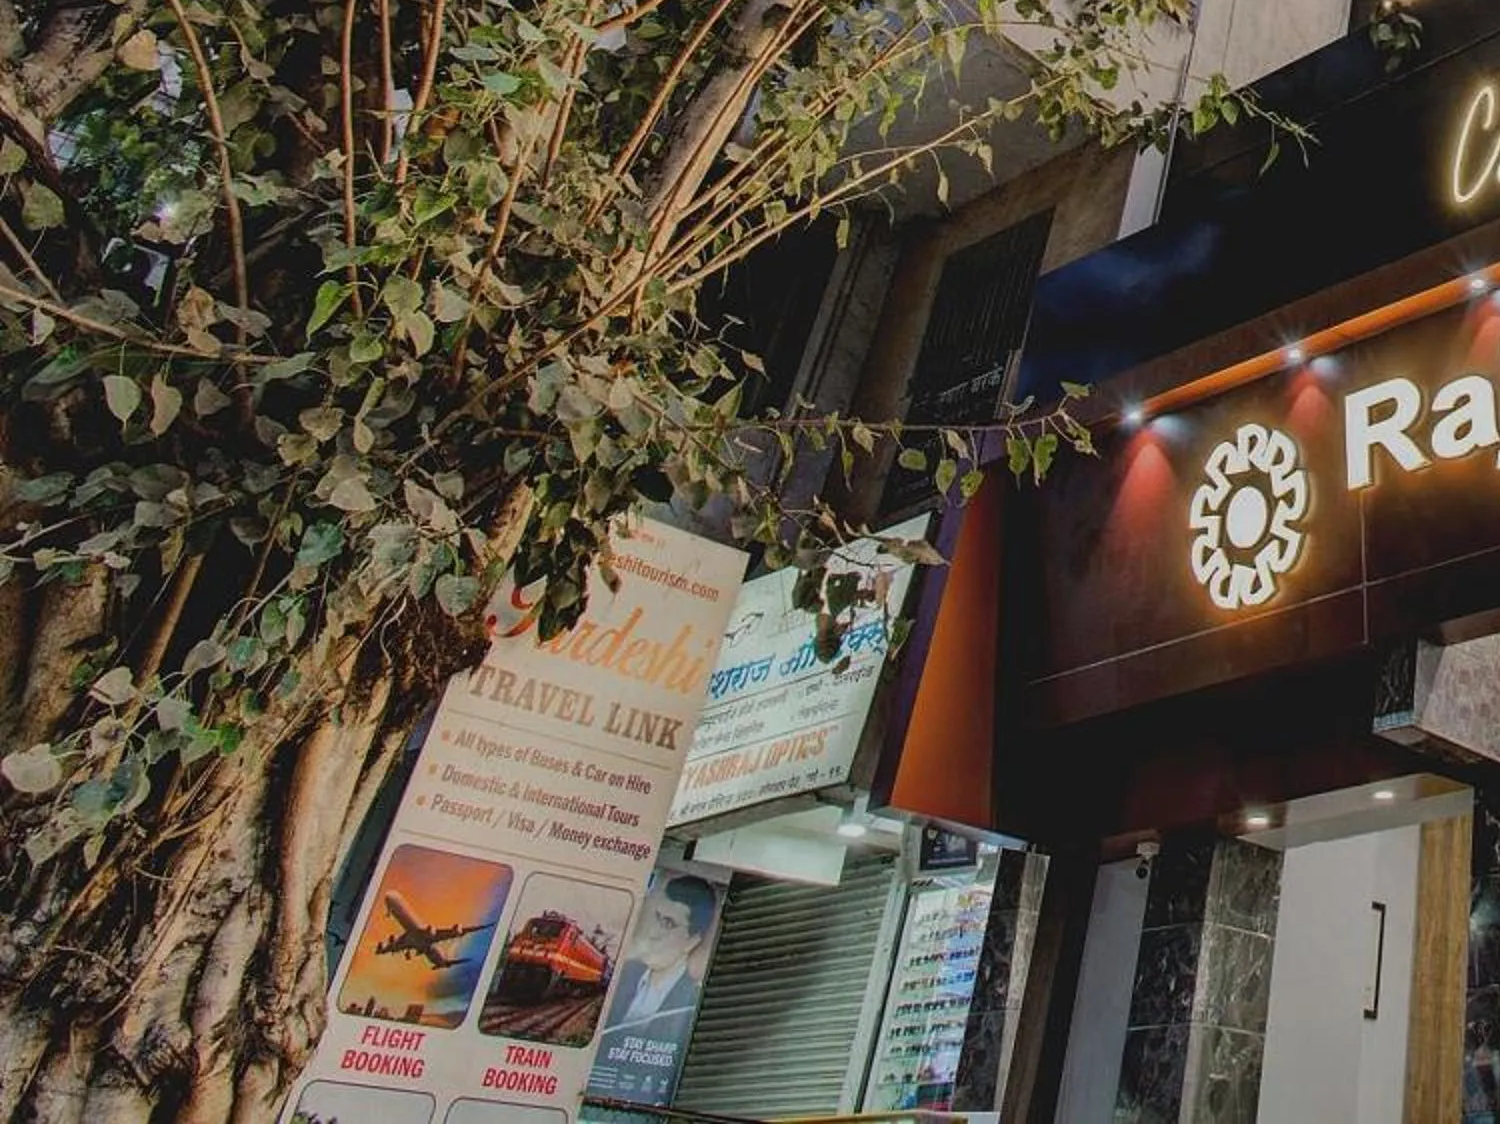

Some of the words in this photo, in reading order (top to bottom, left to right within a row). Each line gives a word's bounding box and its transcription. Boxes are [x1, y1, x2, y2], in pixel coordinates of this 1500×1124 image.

[607, 554, 720, 602] eshitourism.com
[469, 663, 596, 727] TRAVEL
[602, 701, 684, 751] LINK
[454, 729, 475, 749] All
[476, 737, 512, 761] types
[514, 747, 530, 763] of
[571, 761, 584, 777] &
[584, 763, 608, 783] Car
[607, 772, 624, 788] on
[624, 773, 652, 795] Hire
[441, 763, 506, 795] Domestic
[508, 780, 521, 798] &
[606, 804, 640, 827] Tours
[431, 794, 494, 823] Passport
[507, 811, 536, 833] Visa
[548, 821, 592, 851] Money
[592, 834, 652, 861] exchange
[361, 1025, 426, 1051] FLIGHT
[504, 1045, 552, 1069] TRAIN
[340, 1049, 425, 1078] BOOKING
[482, 1068, 558, 1096] BOOKING
